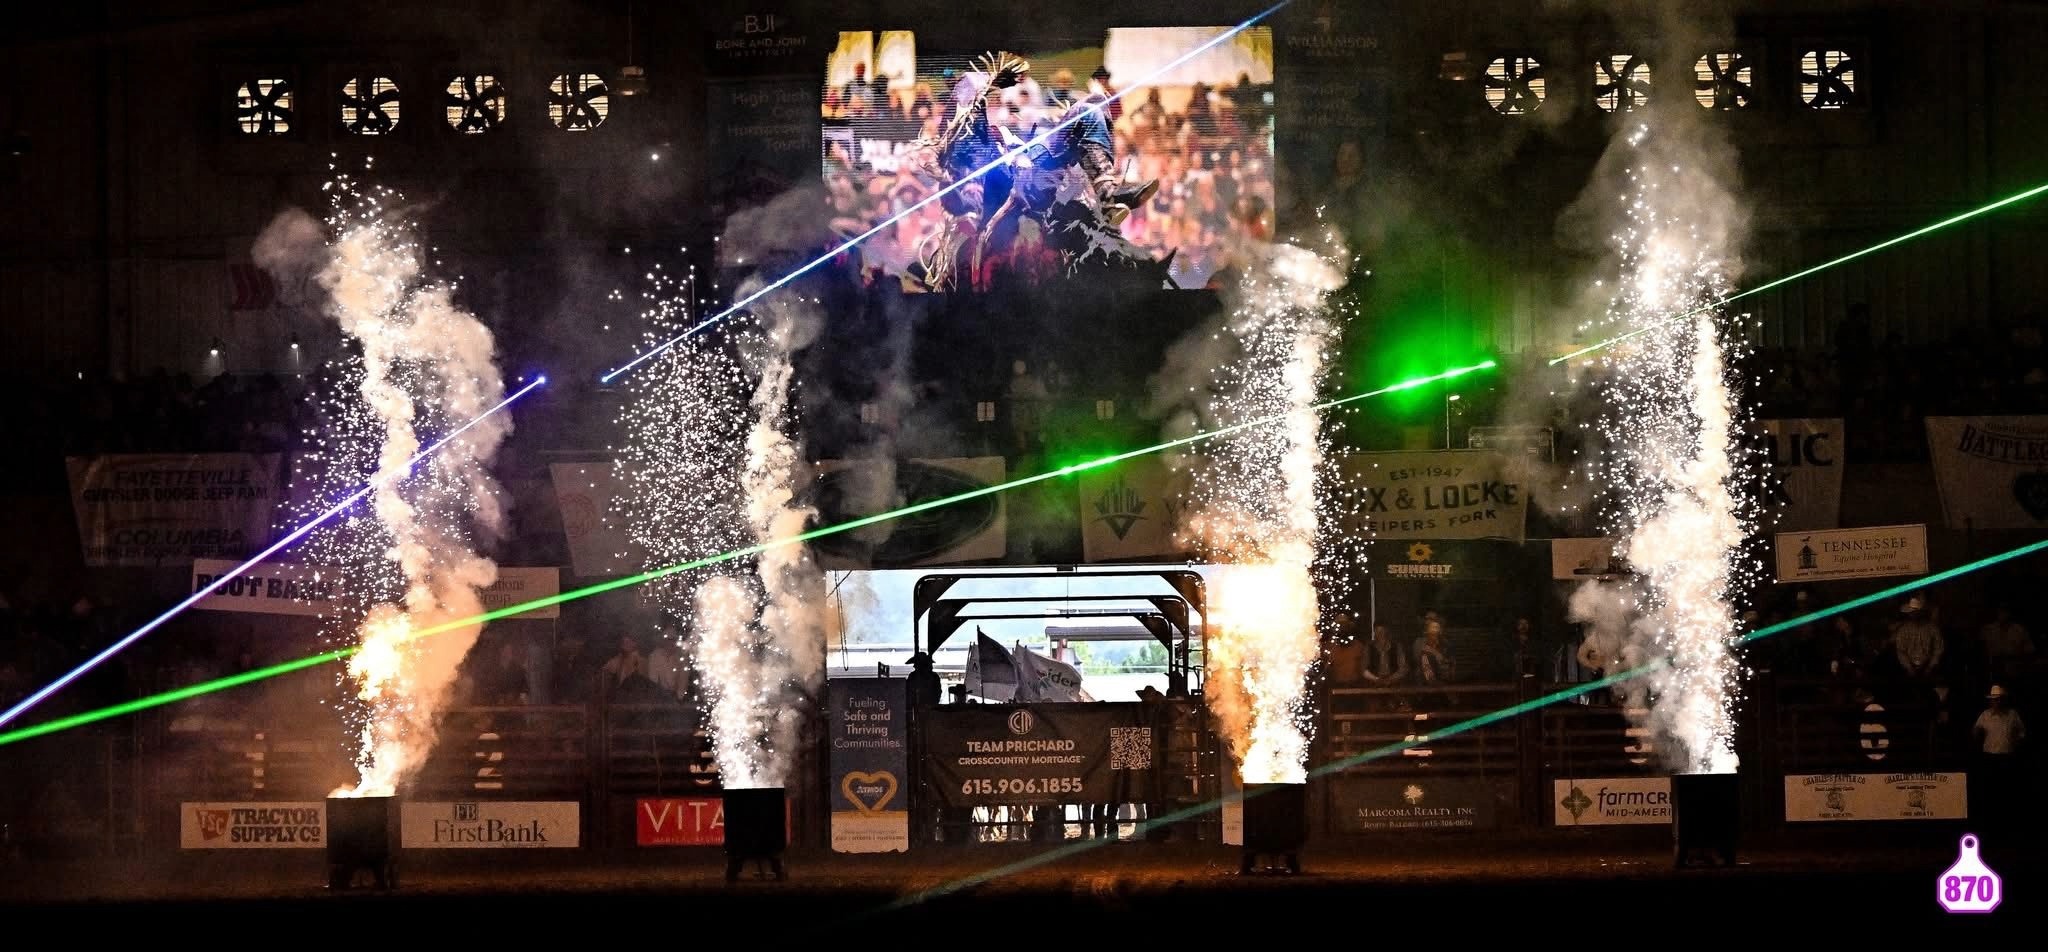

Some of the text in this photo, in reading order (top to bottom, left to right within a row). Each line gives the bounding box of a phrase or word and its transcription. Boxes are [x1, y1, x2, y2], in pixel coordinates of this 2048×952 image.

[115, 471, 252, 485] FAYETTEVILLE
[1394, 487, 1418, 511] &
[1423, 481, 1521, 512] LOCKE
[1357, 508, 1498, 533] LEIPERS FORK
[117, 528, 244, 545] COLUMBIA
[1822, 536, 1908, 553] TENNESSEE
[848, 697, 887, 711] Fueling
[843, 710, 892, 722] Safe and
[845, 724, 889, 737] Thriving
[966, 739, 1076, 754] TEAM PRICHARD
[957, 757, 1030, 766] CROSSCOUNTRY
[961, 777, 1084, 795] 615.906.1855
[231, 808, 320, 825] TRACTOR
[230, 826, 298, 843] SUPPLY
[432, 818, 549, 842] FirstBank
